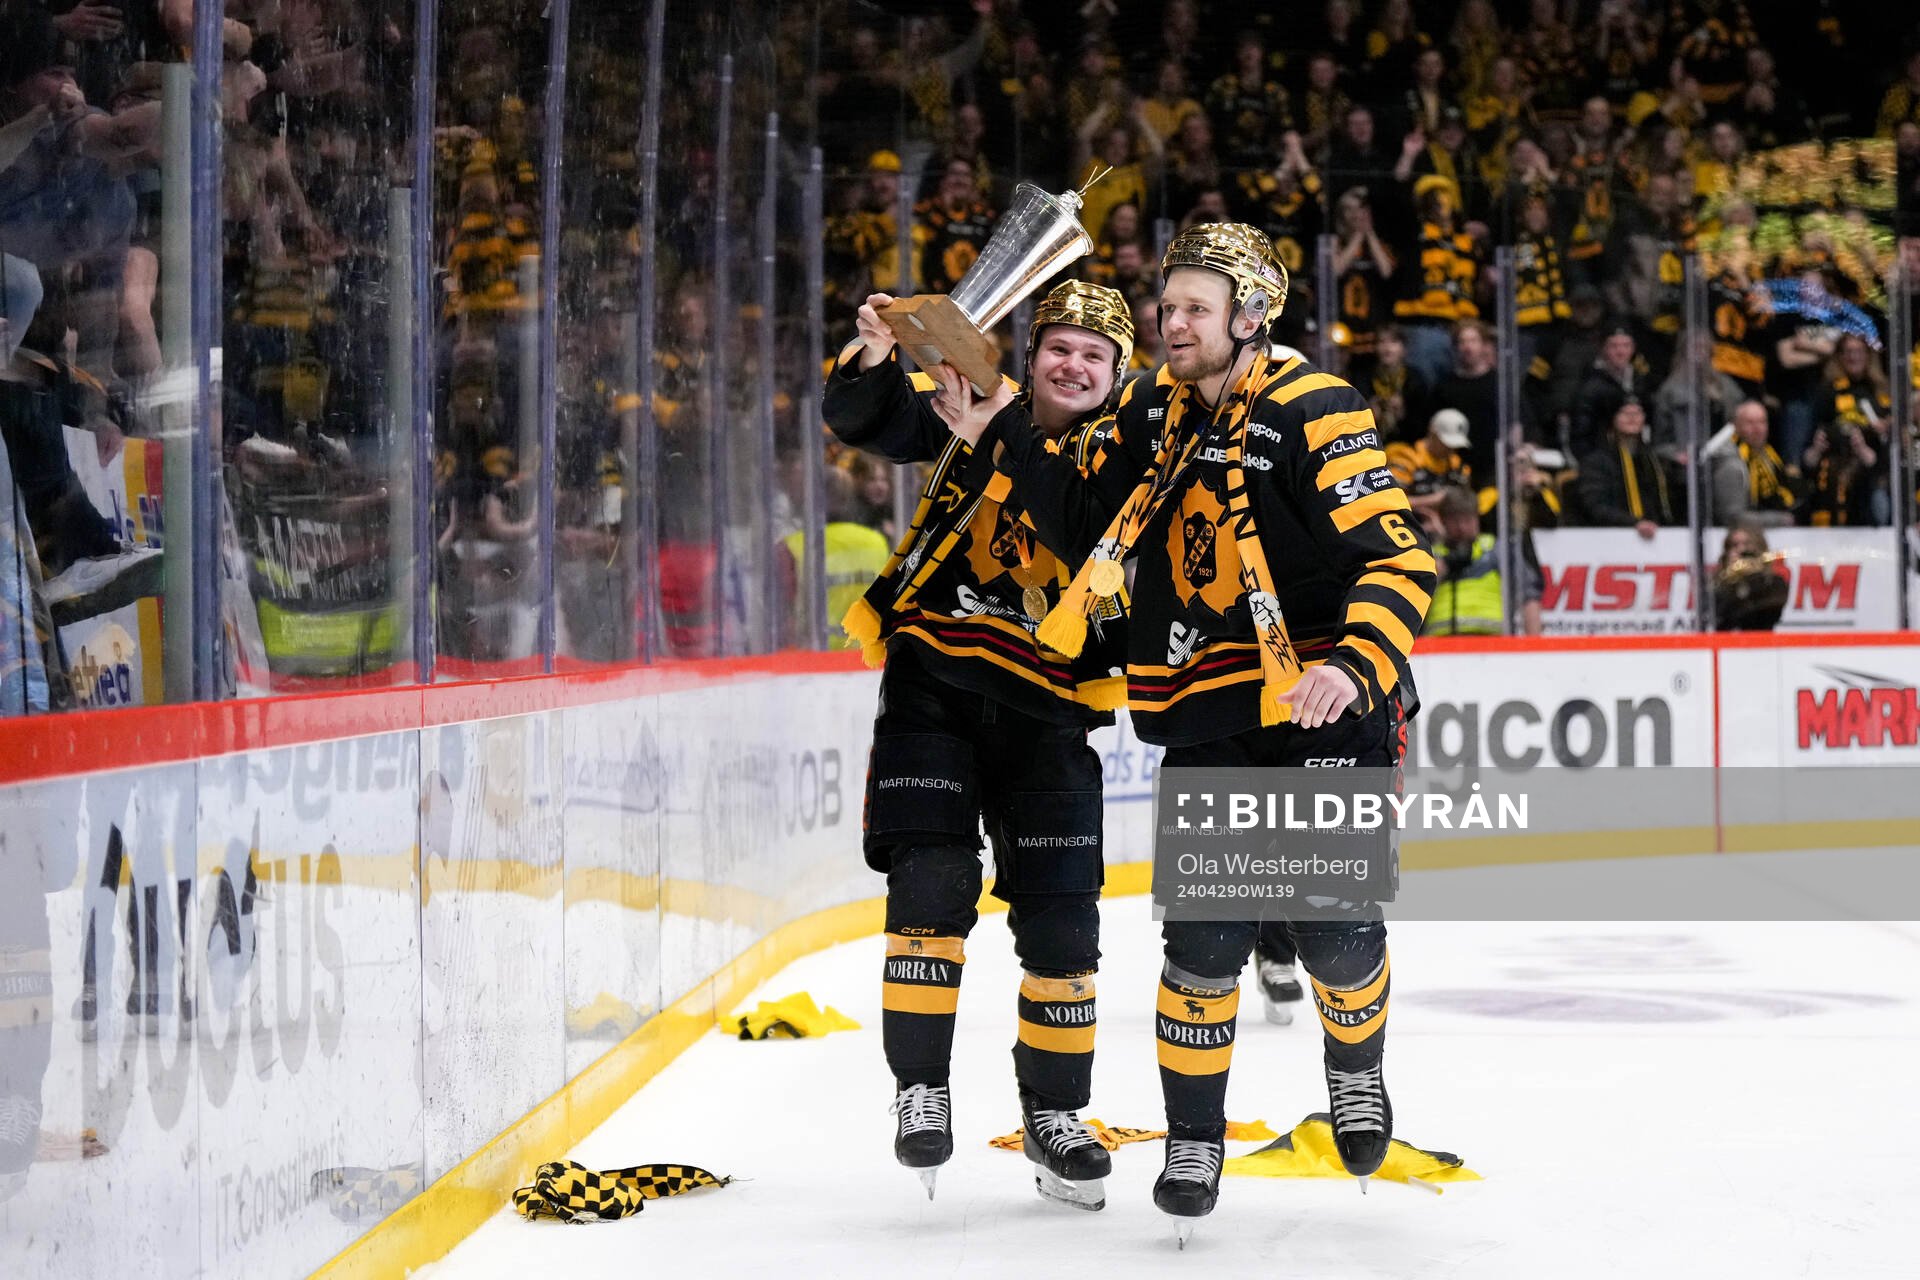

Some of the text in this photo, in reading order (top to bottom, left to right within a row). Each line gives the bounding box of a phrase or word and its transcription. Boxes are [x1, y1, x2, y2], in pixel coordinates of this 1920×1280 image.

[1321, 432, 1377, 462] HOLMEN
[1380, 513, 1417, 549] 6
[1198, 567, 1213, 577] 1921
[1304, 757, 1357, 768] CCM
[879, 777, 962, 793] MARTINSONS
[1018, 835, 1098, 848] MARTINSONS
[900, 926, 936, 936] CCM
[887, 960, 950, 982] NORRAN
[1179, 985, 1222, 996] CCM
[1044, 1004, 1097, 1024] NORR
[1159, 1017, 1233, 1046] NORRAN
